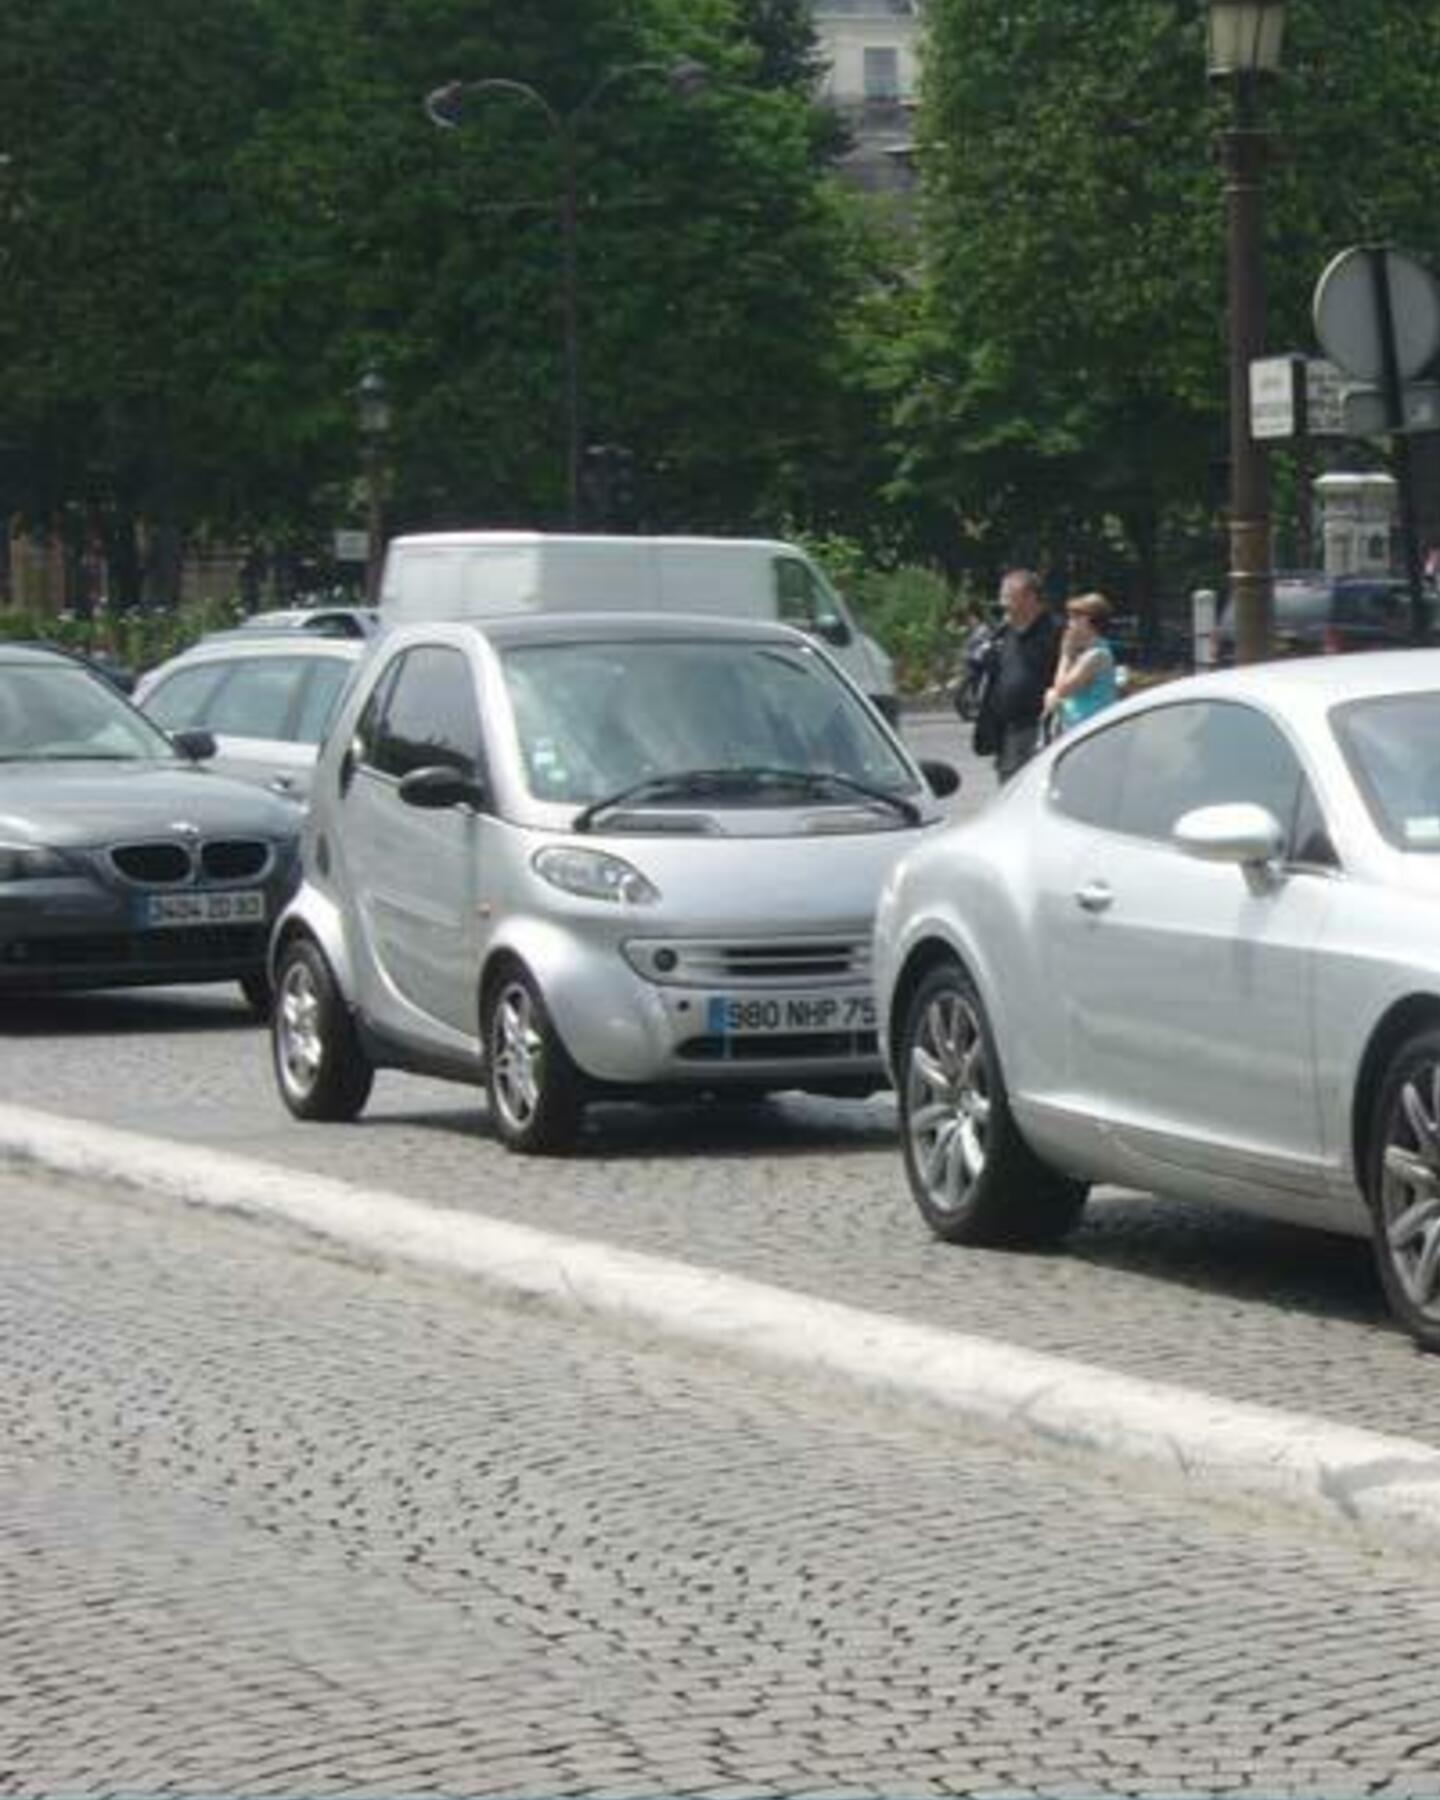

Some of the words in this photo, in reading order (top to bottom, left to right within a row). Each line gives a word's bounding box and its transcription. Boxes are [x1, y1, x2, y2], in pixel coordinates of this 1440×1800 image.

[727, 1000, 781, 1029] 980
[787, 999, 838, 1027] NHP
[842, 997, 876, 1025] 75
